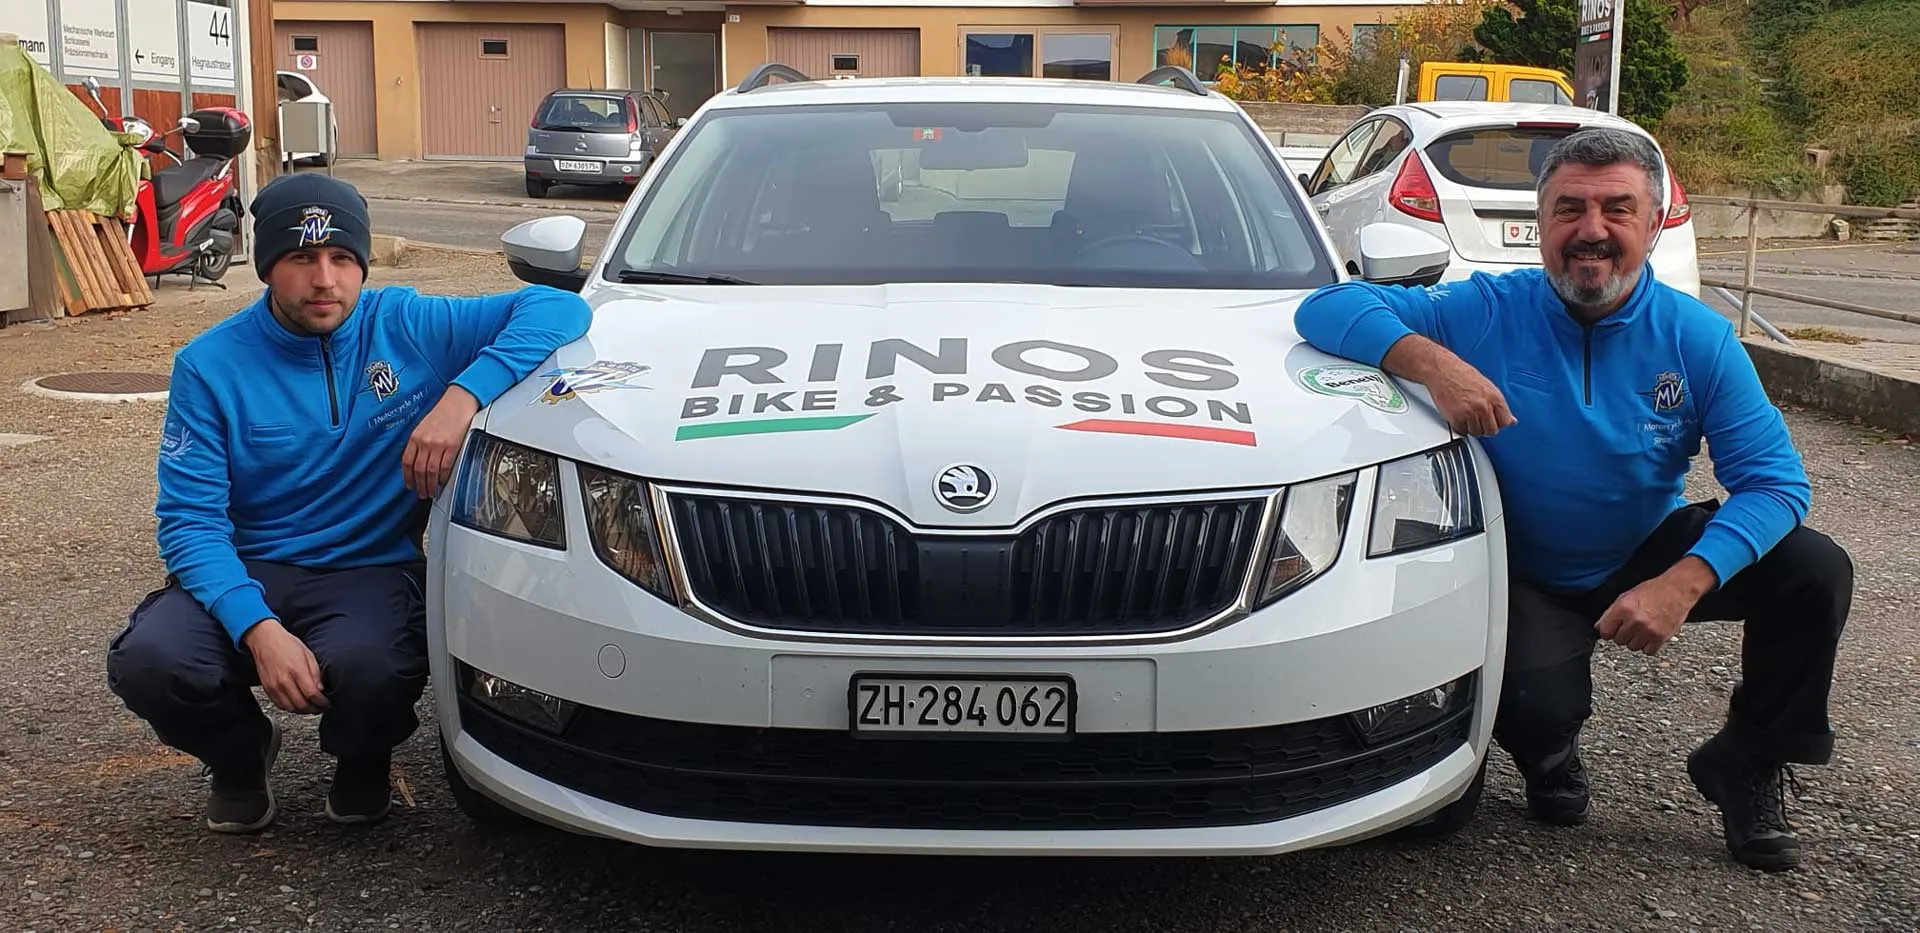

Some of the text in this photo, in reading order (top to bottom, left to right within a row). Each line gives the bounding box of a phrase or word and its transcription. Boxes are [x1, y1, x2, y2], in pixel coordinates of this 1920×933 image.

[210, 10, 229, 47] 44
[151, 52, 175, 68] Eingang
[299, 214, 333, 247] MV
[373, 363, 394, 402] MV
[691, 338, 1239, 391] RINOS
[680, 383, 1252, 425] BIKE & PASSION
[1655, 378, 1684, 412] MV
